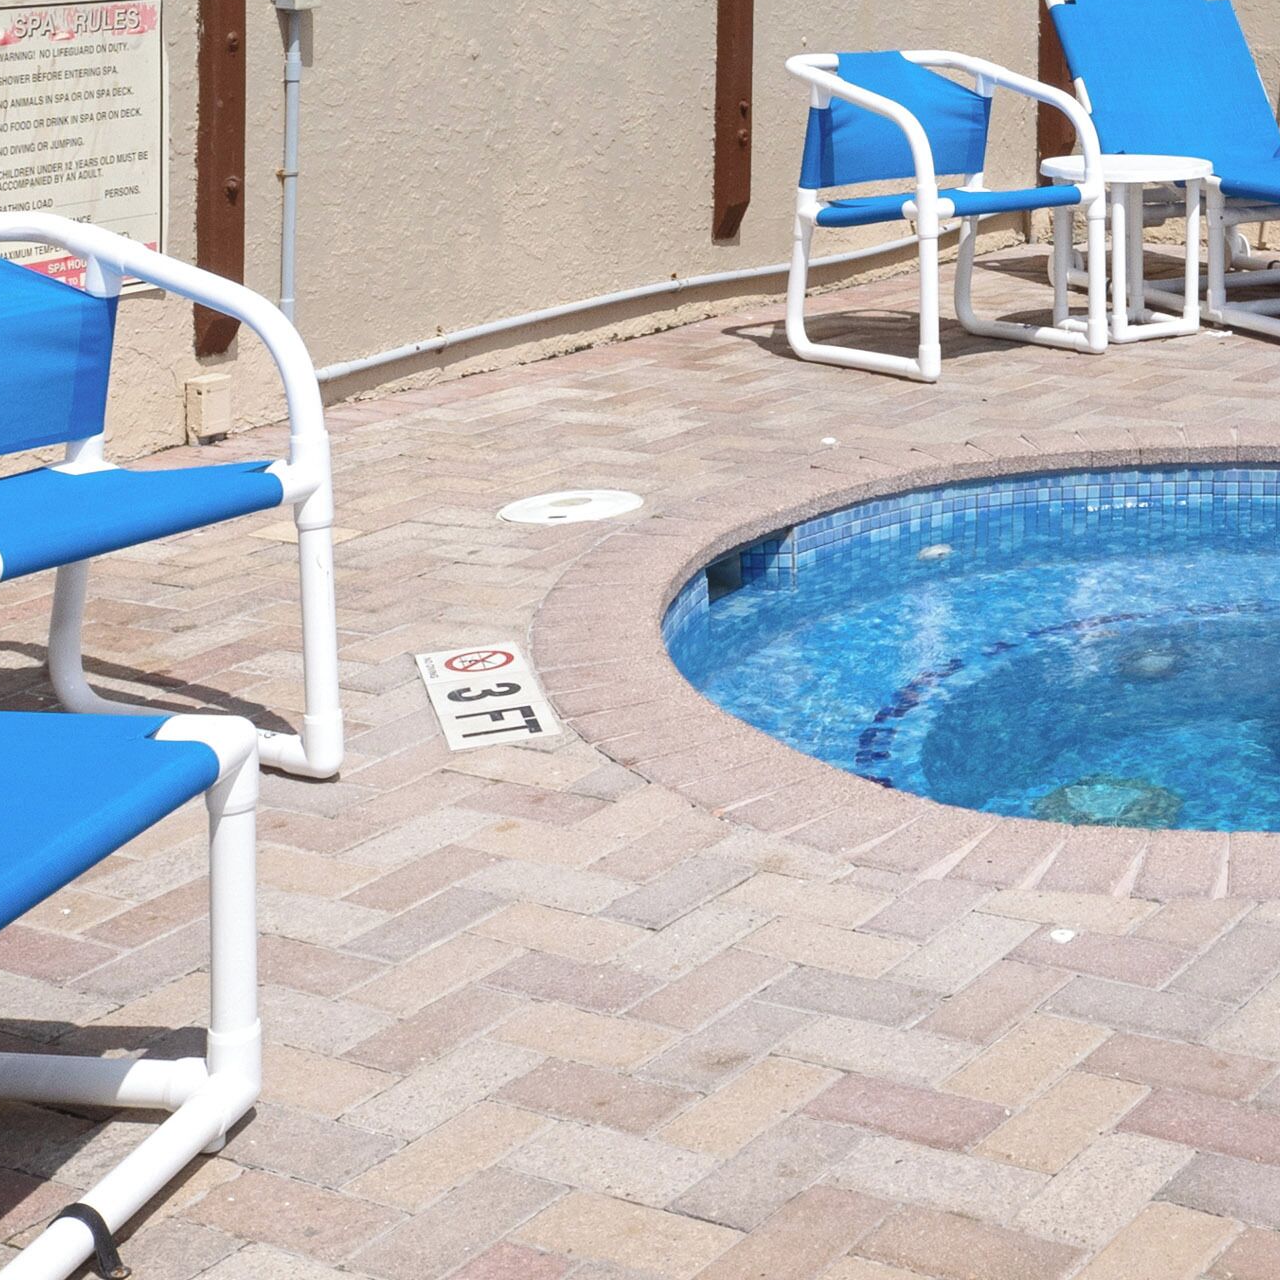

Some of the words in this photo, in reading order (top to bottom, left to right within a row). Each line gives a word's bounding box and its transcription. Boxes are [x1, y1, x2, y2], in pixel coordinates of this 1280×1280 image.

[14, 14, 57, 39] SPA
[75, 9, 141, 34] RULES
[39, 48, 51, 58] NO
[53, 45, 94, 57] LIFEGUARD
[96, 43, 107, 53] ON
[108, 42, 129, 53] DUTY.
[32, 71, 62, 82] BEFORE
[64, 67, 101, 79] ENTERING
[103, 65, 118, 75] SPA.
[10, 96, 43, 109] ANIMALS
[45, 94, 53, 104] IN
[55, 92, 69, 102] SPA
[71, 90, 82, 100] OR
[84, 89, 94, 99] ON
[96, 87, 111, 98] SPA
[112, 86, 134, 96] DECK.
[10, 121, 31, 132] FOOD
[34, 118, 44, 129] OR
[46, 116, 69, 127] DRINK
[72, 115, 78, 124] IN
[79, 113, 94, 123] SPA
[96, 111, 107, 121] OR
[108, 110, 119, 120] ON
[120, 108, 142, 118] DECK.
[10, 142, 36, 155] DIVING
[38, 141, 48, 152] OR
[50, 137, 84, 150] JUMPING.
[37, 163, 63, 175] UNDER
[65, 162, 73, 171] 12
[75, 158, 98, 170] YEARS
[100, 156, 115, 166] OLD
[117, 153, 136, 164] MUST
[138, 151, 148, 161] BE
[54, 173, 64, 183] BY
[66, 171, 76, 182] AN
[78, 168, 103, 180] ADULT.
[32, 198, 53, 210] LOAD
[105, 186, 140, 199] PERSONS.
[47, 262, 66, 274] SPA
[447, 682, 521, 702] 3
[455, 705, 543, 738] FT
